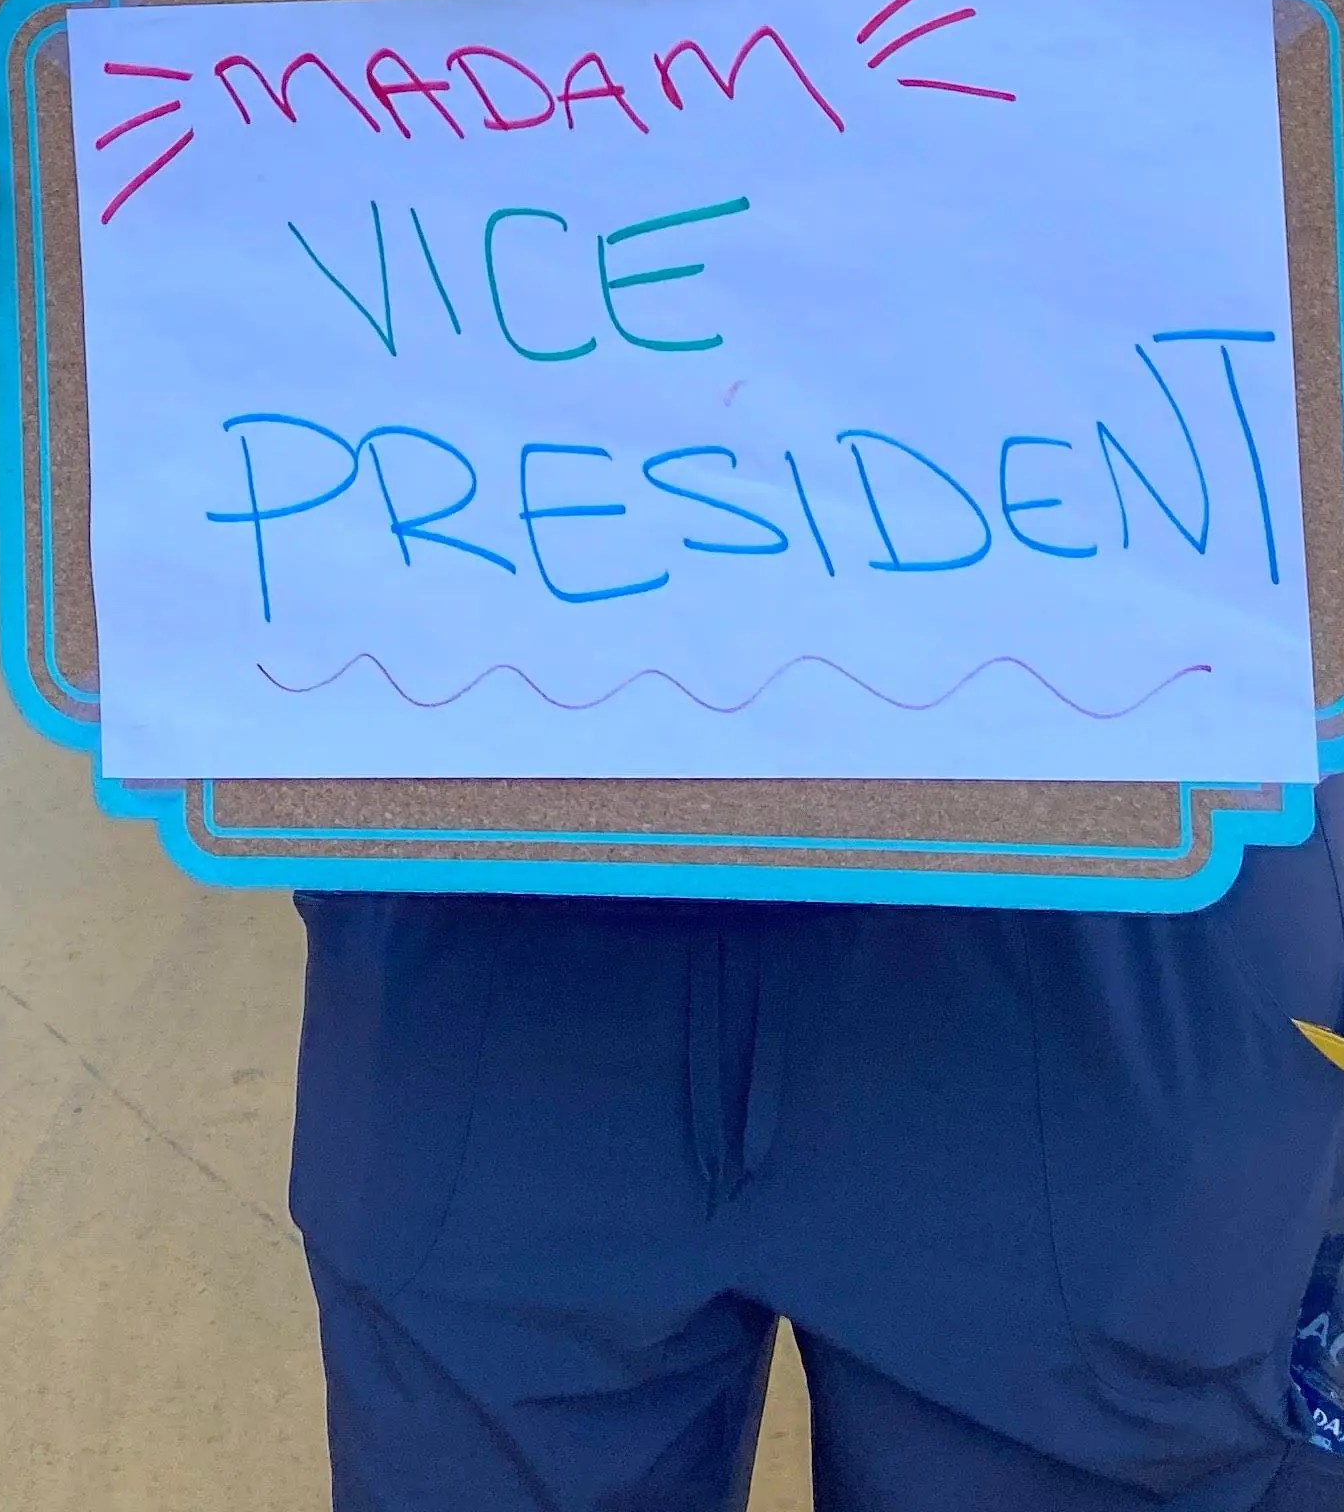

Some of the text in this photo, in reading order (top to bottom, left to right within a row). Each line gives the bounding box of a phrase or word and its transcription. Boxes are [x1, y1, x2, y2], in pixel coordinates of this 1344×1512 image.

[213, 24, 845, 140] MADAM
[286, 195, 751, 362] VICE
[205, 330, 1280, 624] PRESIDENT
